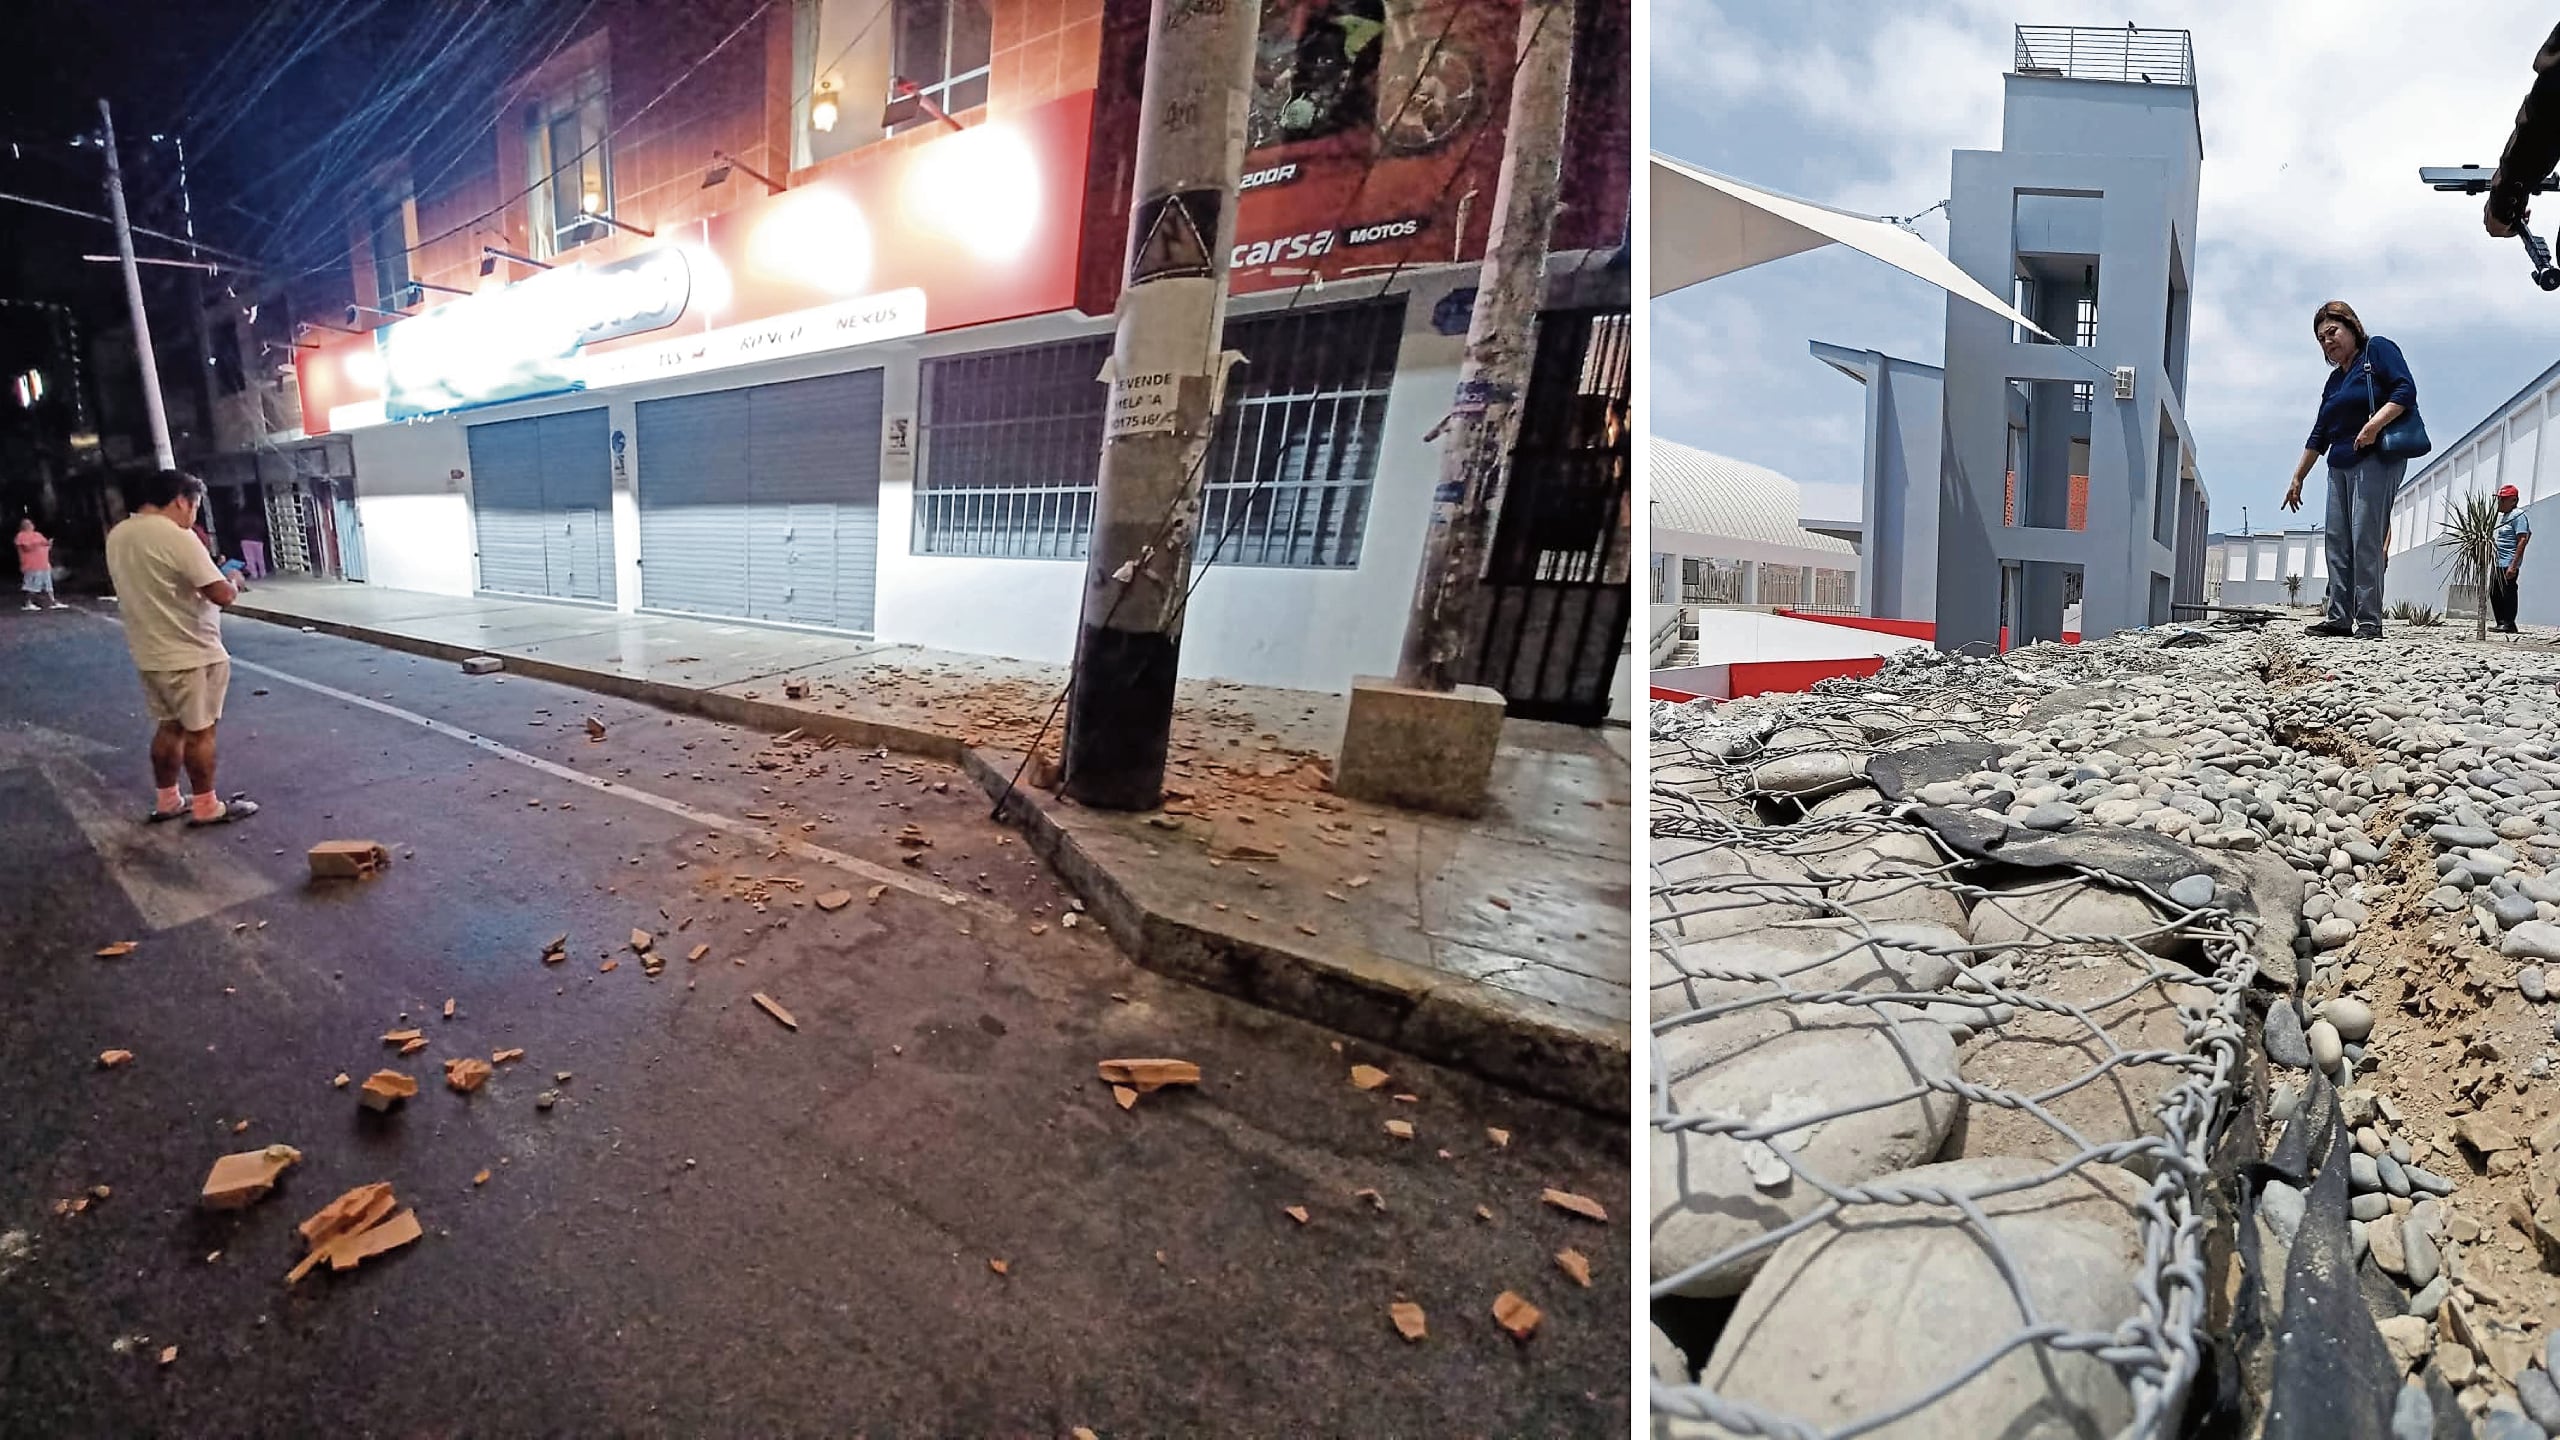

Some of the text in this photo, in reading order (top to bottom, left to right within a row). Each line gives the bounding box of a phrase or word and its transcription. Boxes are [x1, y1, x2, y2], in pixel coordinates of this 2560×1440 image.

[1239, 163, 1297, 189] 200R
[1229, 220, 1417, 268] carsa MOTOS
[836, 307, 898, 331] NEXUS
[1126, 373, 1172, 389] VENDE
